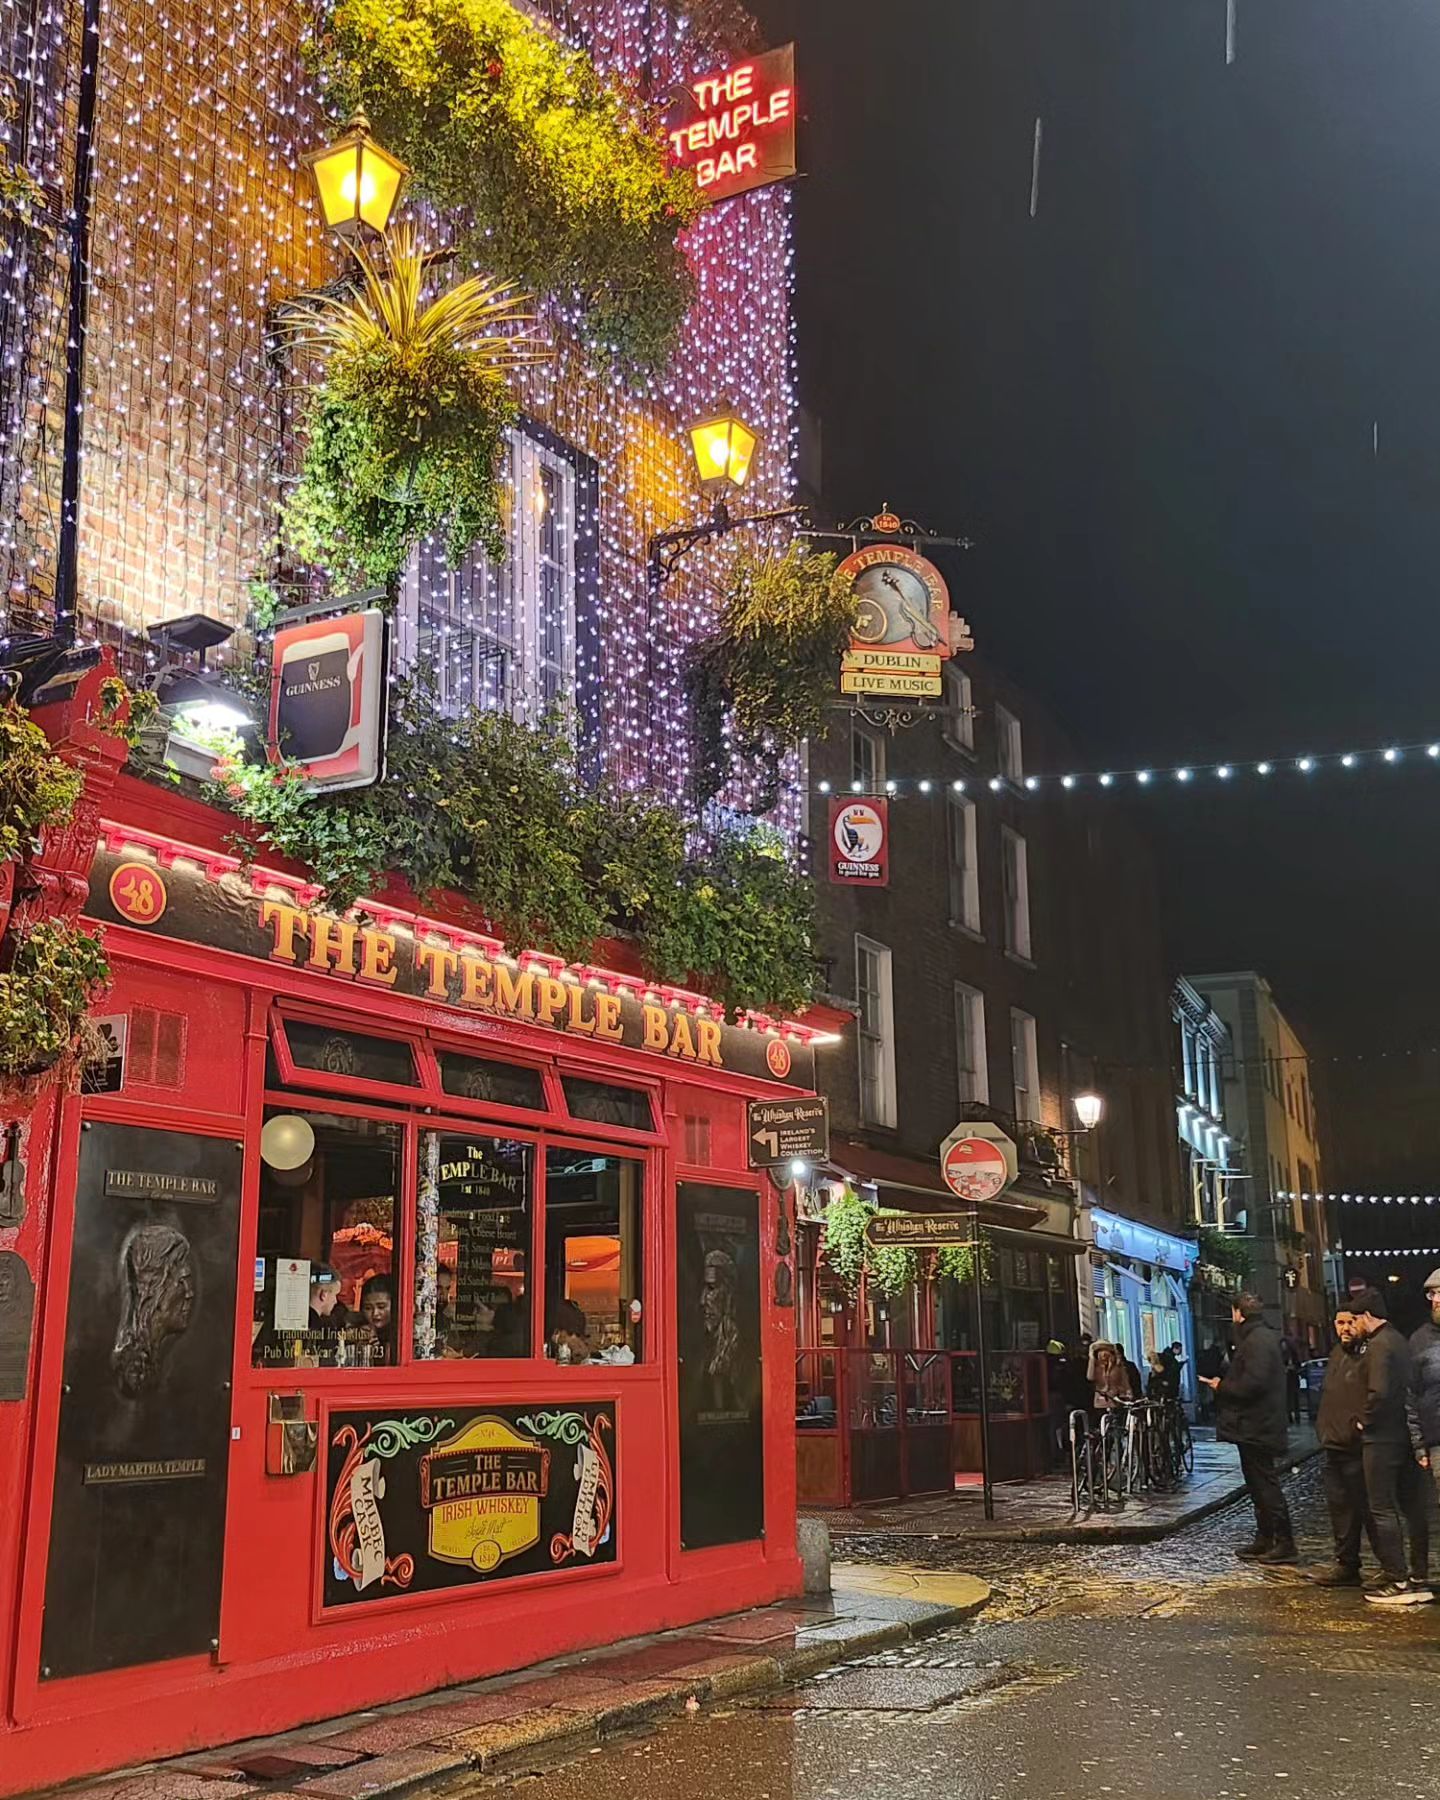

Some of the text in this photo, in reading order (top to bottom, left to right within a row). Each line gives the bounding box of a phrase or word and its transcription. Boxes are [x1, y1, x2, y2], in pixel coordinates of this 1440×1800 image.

[693, 65, 753, 111] THE
[669, 89, 791, 158] TEMPLE
[696, 143, 758, 188] BAR
[854, 550, 943, 610] TEMPLE BAR
[864, 654, 921, 668] DUBLIN
[286, 676, 341, 696] GUINNESS
[853, 676, 934, 692] LIVE MUSIC
[838, 862, 879, 872] GUINNESS
[120, 876, 154, 915] 48
[260, 900, 724, 1067] THE TEMPLE BAR
[770, 1046, 787, 1071] 48
[761, 1108, 794, 1124] Whiskey
[794, 1106, 823, 1121] Reserve
[466, 1146, 483, 1160] The
[780, 1149, 824, 1157] COLLECTION
[109, 1171, 135, 1186] THE
[138, 1175, 189, 1191] TEMPLE
[191, 1180, 216, 1195] BAR
[440, 1161, 517, 1193] EMPLE BAR
[884, 1219, 924, 1236] Whiskey
[925, 1218, 960, 1235] Reserve
[277, 1328, 325, 1340] Traditional
[263, 1345, 281, 1359] Pub
[312, 1345, 333, 1359] Year
[87, 1459, 205, 1478] LADY MARTHA TEMPLE
[474, 1454, 501, 1471] THE
[433, 1471, 539, 1500] TEMPLE BAR
[442, 1497, 530, 1524] IRISH WHISKEY
[574, 1468, 590, 1538] EDITION
[354, 1498, 372, 1551] CASK
[361, 1477, 383, 1561] MALBEC
